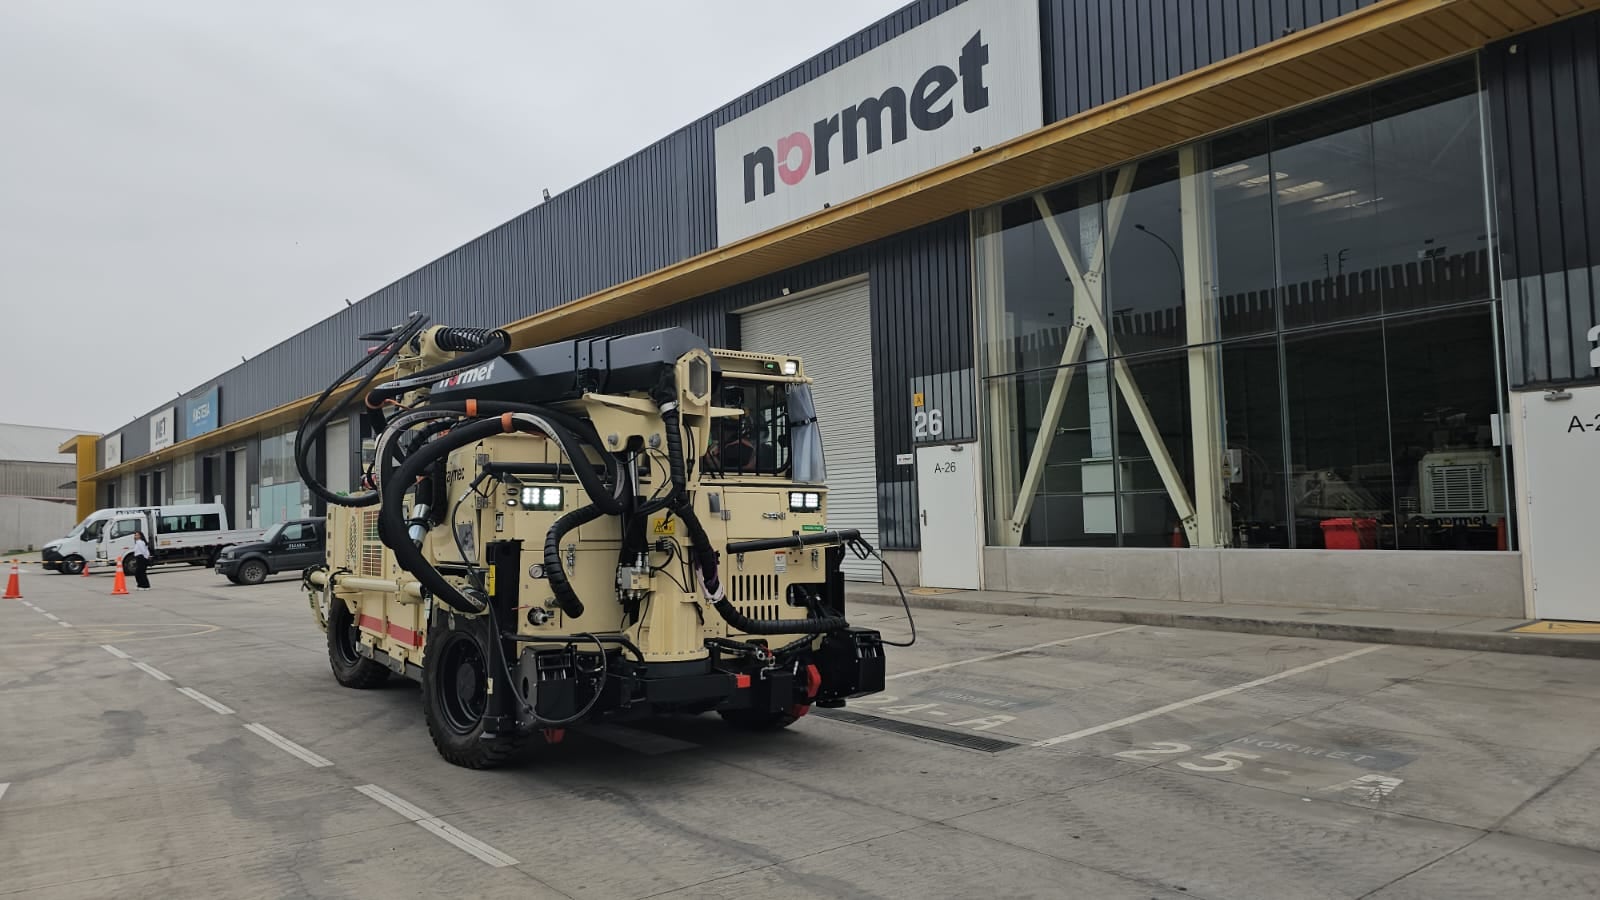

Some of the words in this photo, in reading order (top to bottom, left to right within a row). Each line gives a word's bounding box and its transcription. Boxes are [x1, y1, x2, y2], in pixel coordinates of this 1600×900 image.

[743, 29, 989, 204] normet
[914, 408, 943, 437] 26
[934, 461, 957, 474] A-26
[1232, 735, 1377, 764] NORMET
